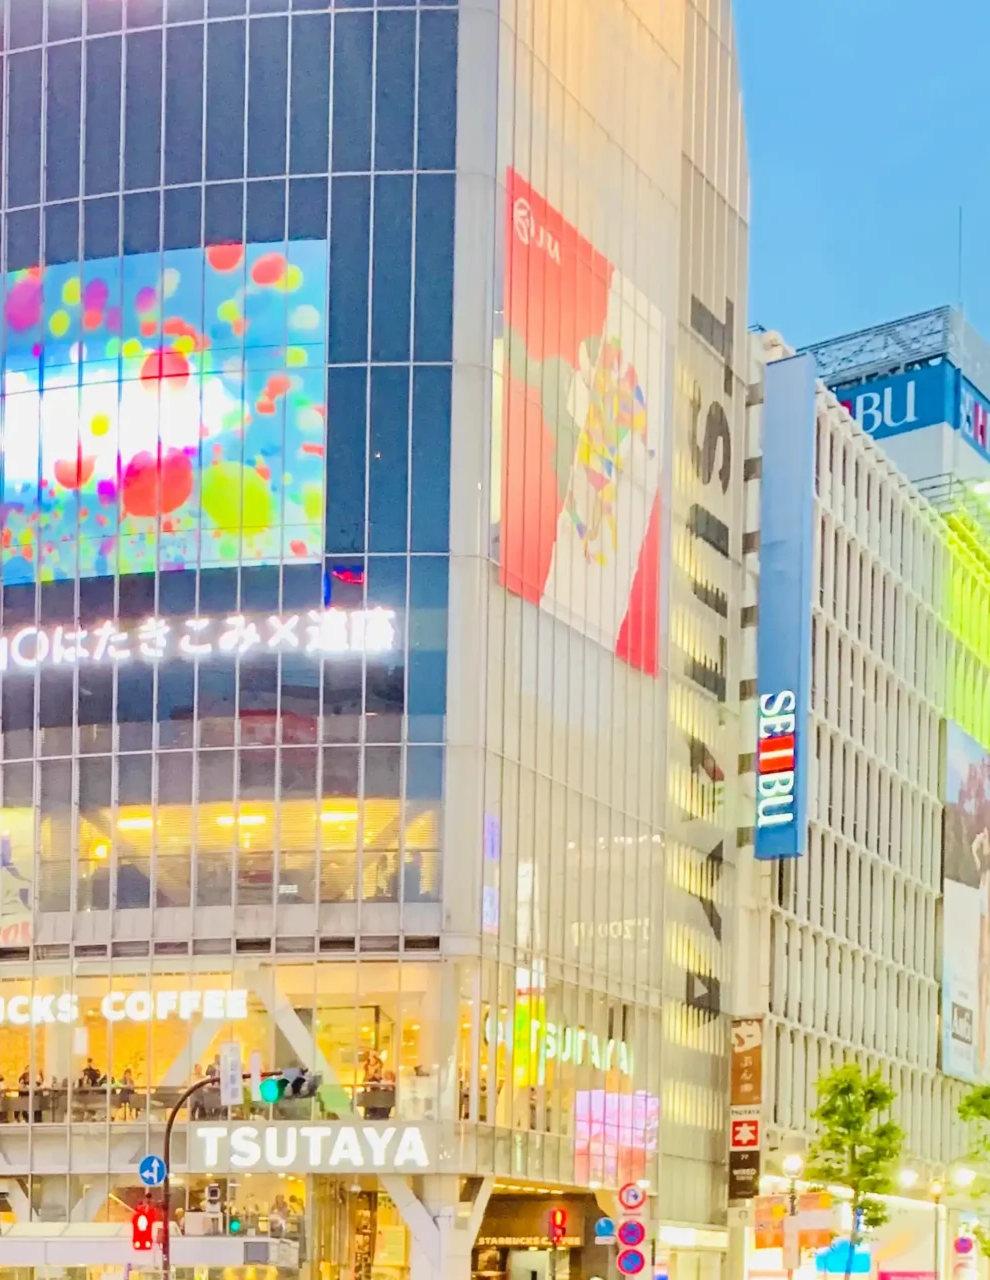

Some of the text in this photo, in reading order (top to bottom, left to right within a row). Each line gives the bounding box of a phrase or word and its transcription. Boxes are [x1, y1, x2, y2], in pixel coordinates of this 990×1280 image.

[841, 380, 918, 434] BU
[758, 690, 796, 829] SEIBU
[101, 989, 248, 1021] COFFEE
[197, 1126, 430, 1167] TSUTAYA
[478, 1236, 581, 1245] STARBUCKS CFEE
